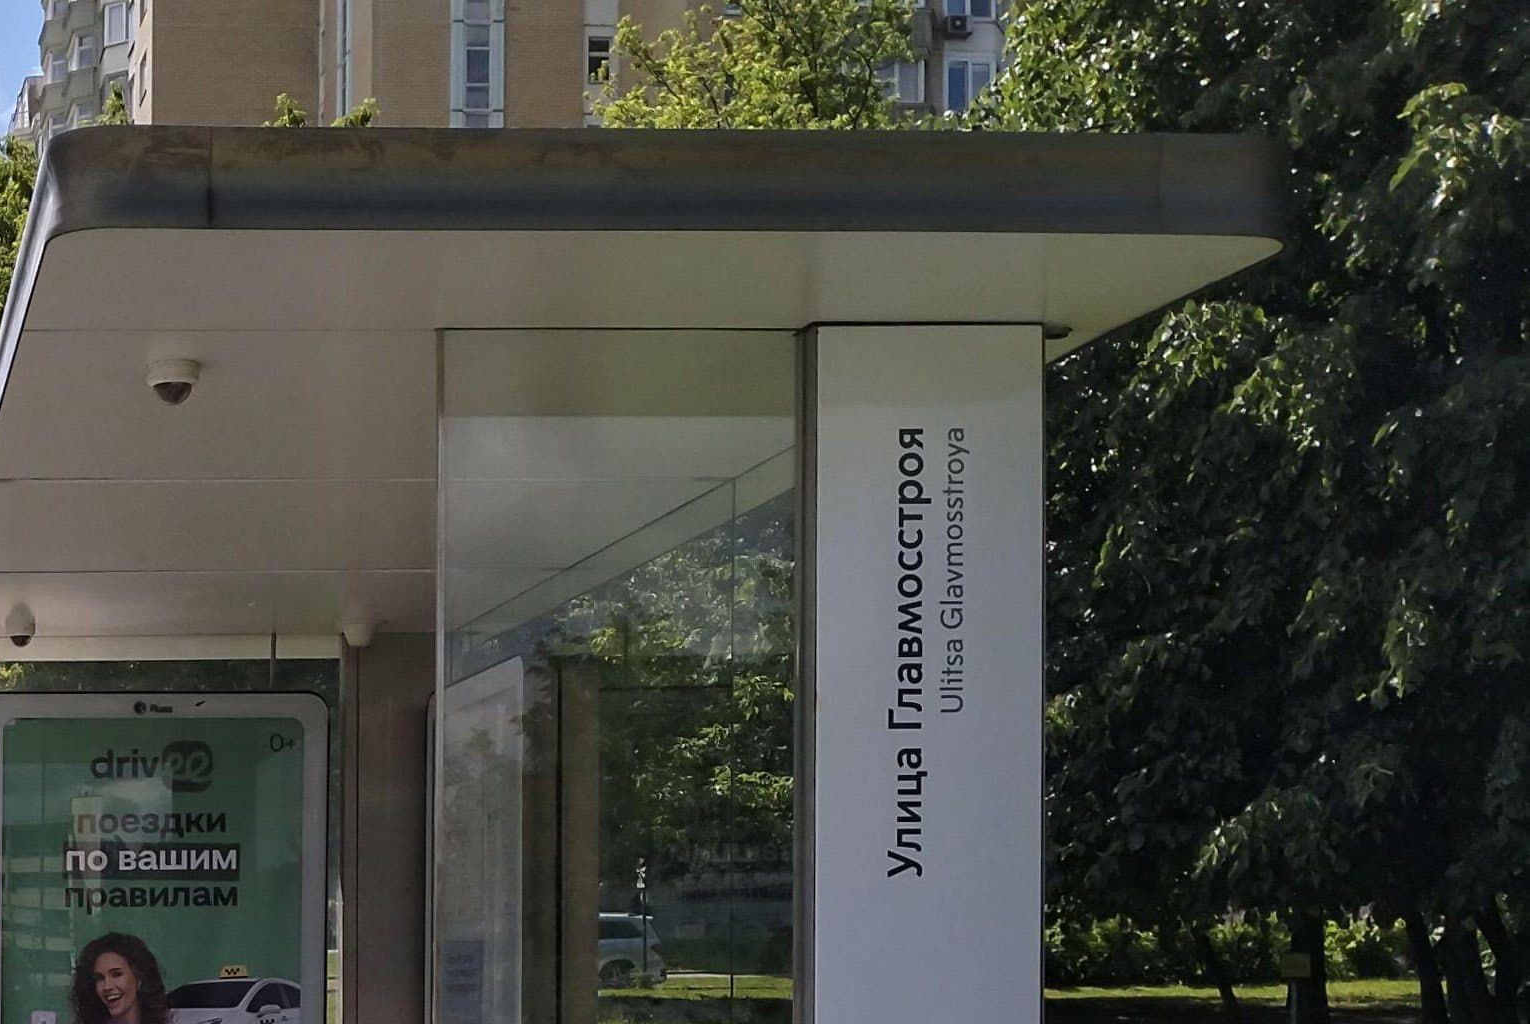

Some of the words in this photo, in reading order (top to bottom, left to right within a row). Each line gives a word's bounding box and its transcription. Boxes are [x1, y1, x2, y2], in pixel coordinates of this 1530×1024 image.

[940, 427, 971, 630] Glavmosstroya
[887, 428, 932, 730] Главмосстроя
[940, 638, 964, 714] Ulitsa
[270, 734, 294, 752] 0+
[76, 811, 228, 839] поездки
[887, 747, 928, 877] Улица
[65, 849, 108, 872] по
[118, 849, 238, 872] вашим
[64, 886, 239, 916] правилам
